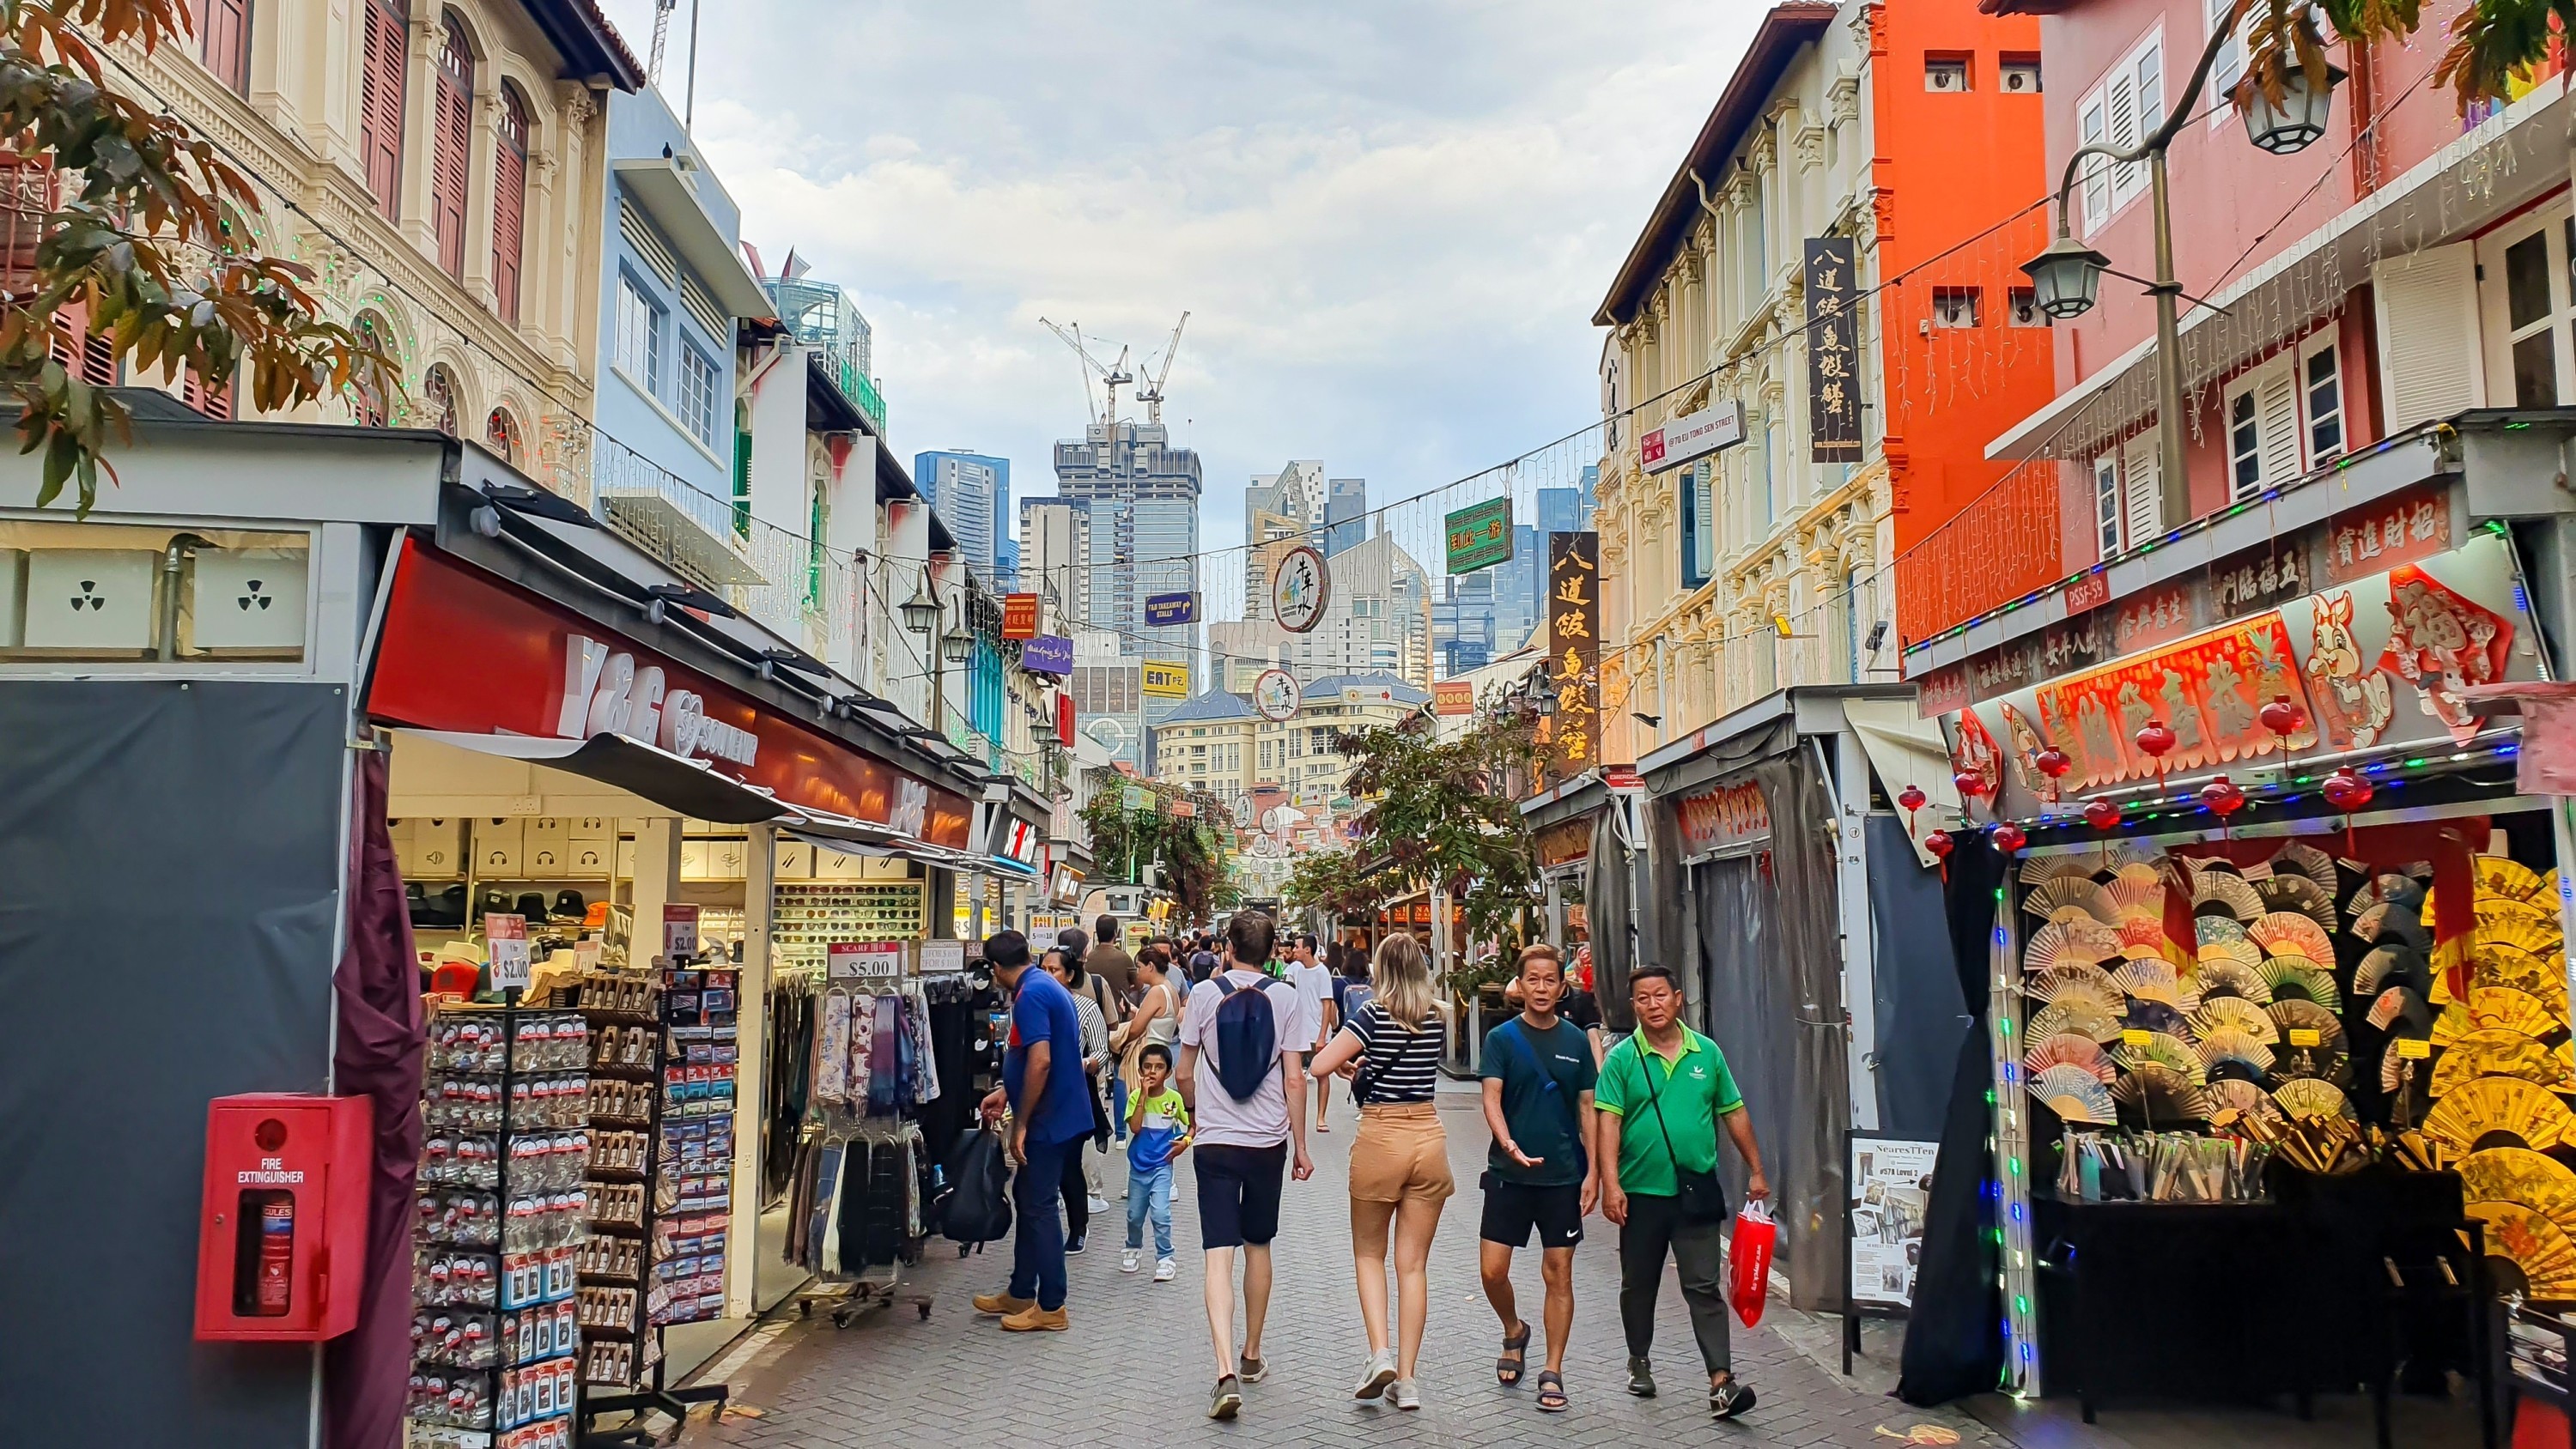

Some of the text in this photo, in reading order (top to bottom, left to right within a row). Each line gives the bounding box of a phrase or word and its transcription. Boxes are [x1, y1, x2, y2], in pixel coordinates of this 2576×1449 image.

[1682, 433, 1689, 443] EU
[1690, 427, 1704, 440] TONG
[1704, 423, 1715, 434] SEN
[1716, 415, 1735, 430] STREET
[1449, 519, 1503, 552] 到此一游
[1157, 600, 1182, 610] TAKEAWAY
[1156, 609, 1174, 619] STALLS
[1146, 670, 1184, 687] EAT 吃
[557, 634, 665, 746] Y&G
[674, 937, 697, 950] $2.00
[841, 944, 869, 953] SCARF
[503, 961, 528, 979] $2.00
[849, 961, 890, 977] $5.00
[261, 1158, 283, 1170] FIRE
[238, 1171, 304, 1184] EXTINGUISHER
